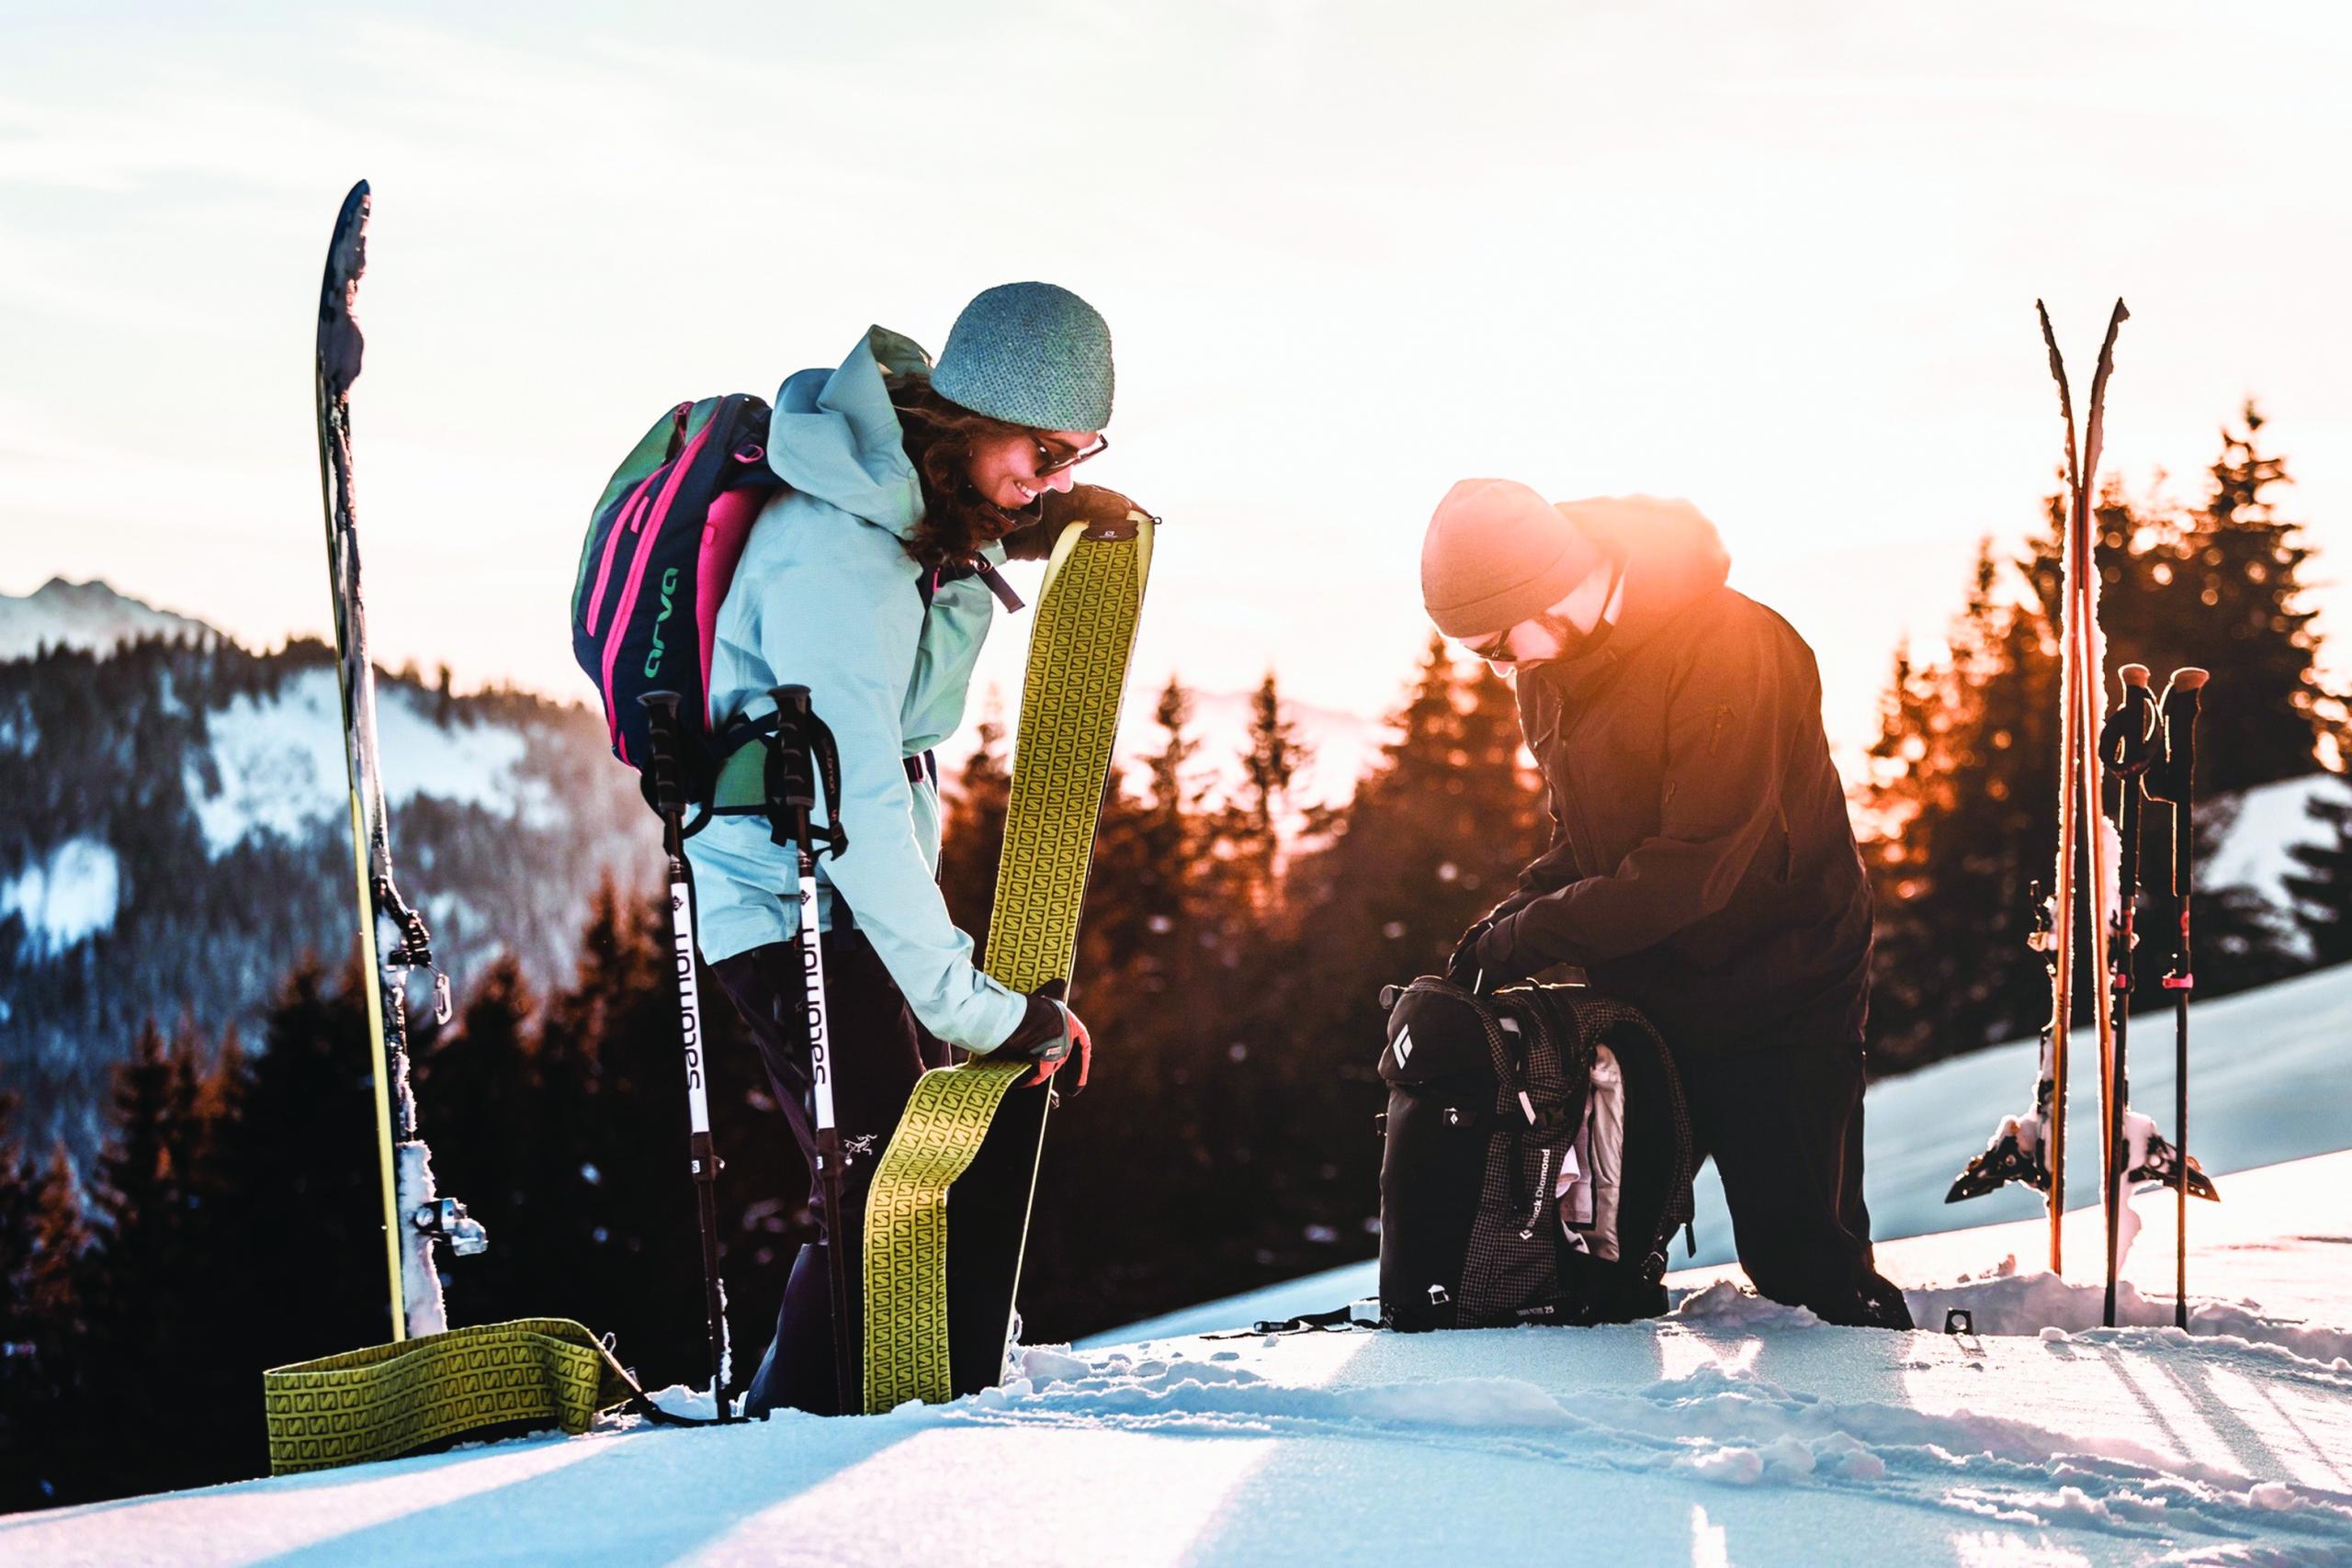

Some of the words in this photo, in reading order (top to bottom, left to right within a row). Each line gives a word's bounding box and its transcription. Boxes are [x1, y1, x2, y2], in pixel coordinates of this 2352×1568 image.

[674, 933, 700, 1091] salomon
[802, 928, 826, 1086] salomon
[1534, 1148, 1551, 1198] Diamond
[1544, 1305, 1555, 1314] 25
